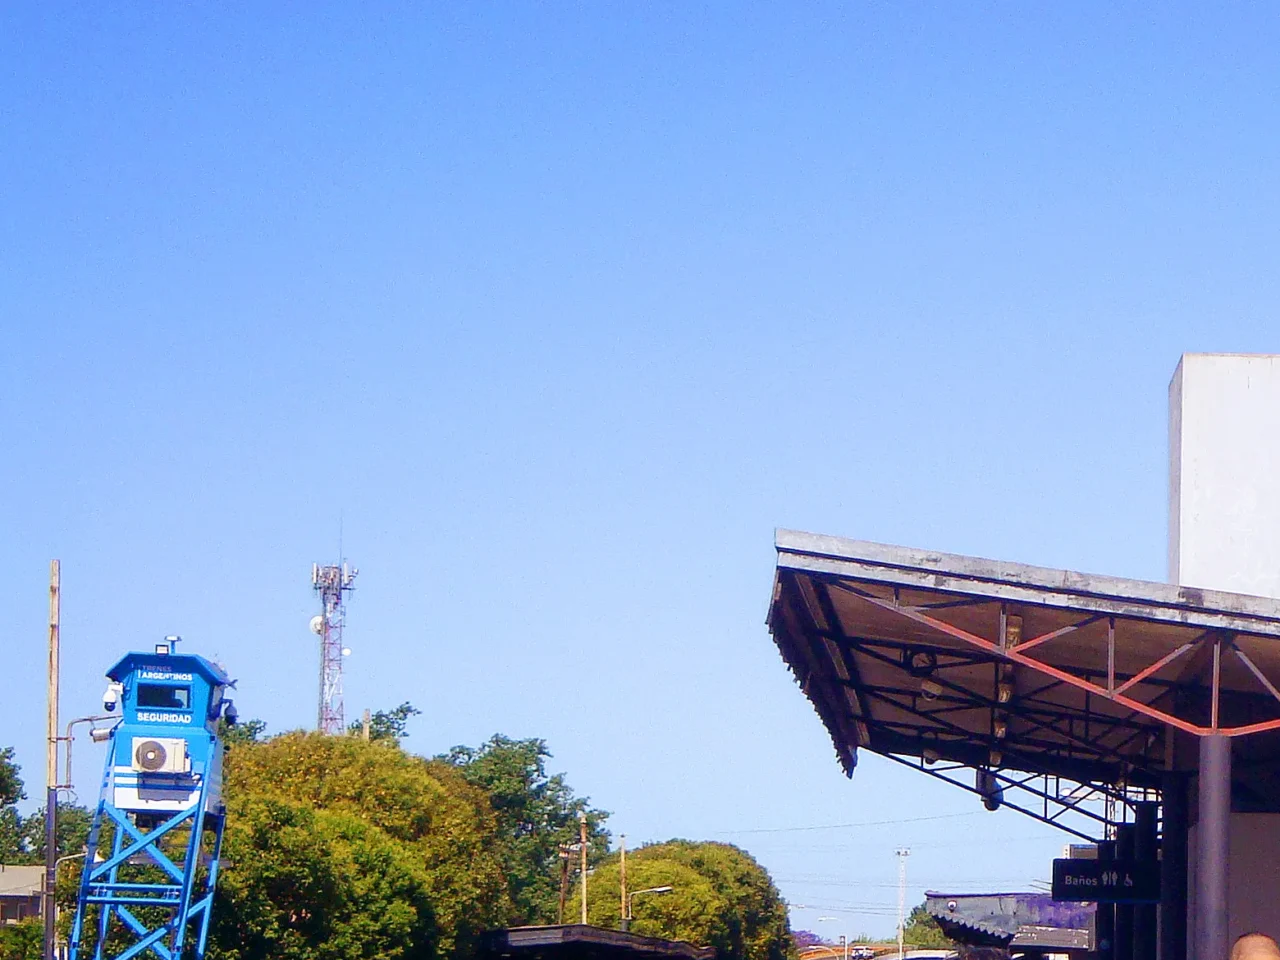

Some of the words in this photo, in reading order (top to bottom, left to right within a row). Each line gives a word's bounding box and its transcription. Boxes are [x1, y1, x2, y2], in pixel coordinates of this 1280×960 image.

[141, 671, 193, 681] ARGENTINOS
[137, 712, 192, 724] SEGURIDAD
[1064, 875, 1098, 886] Baños
